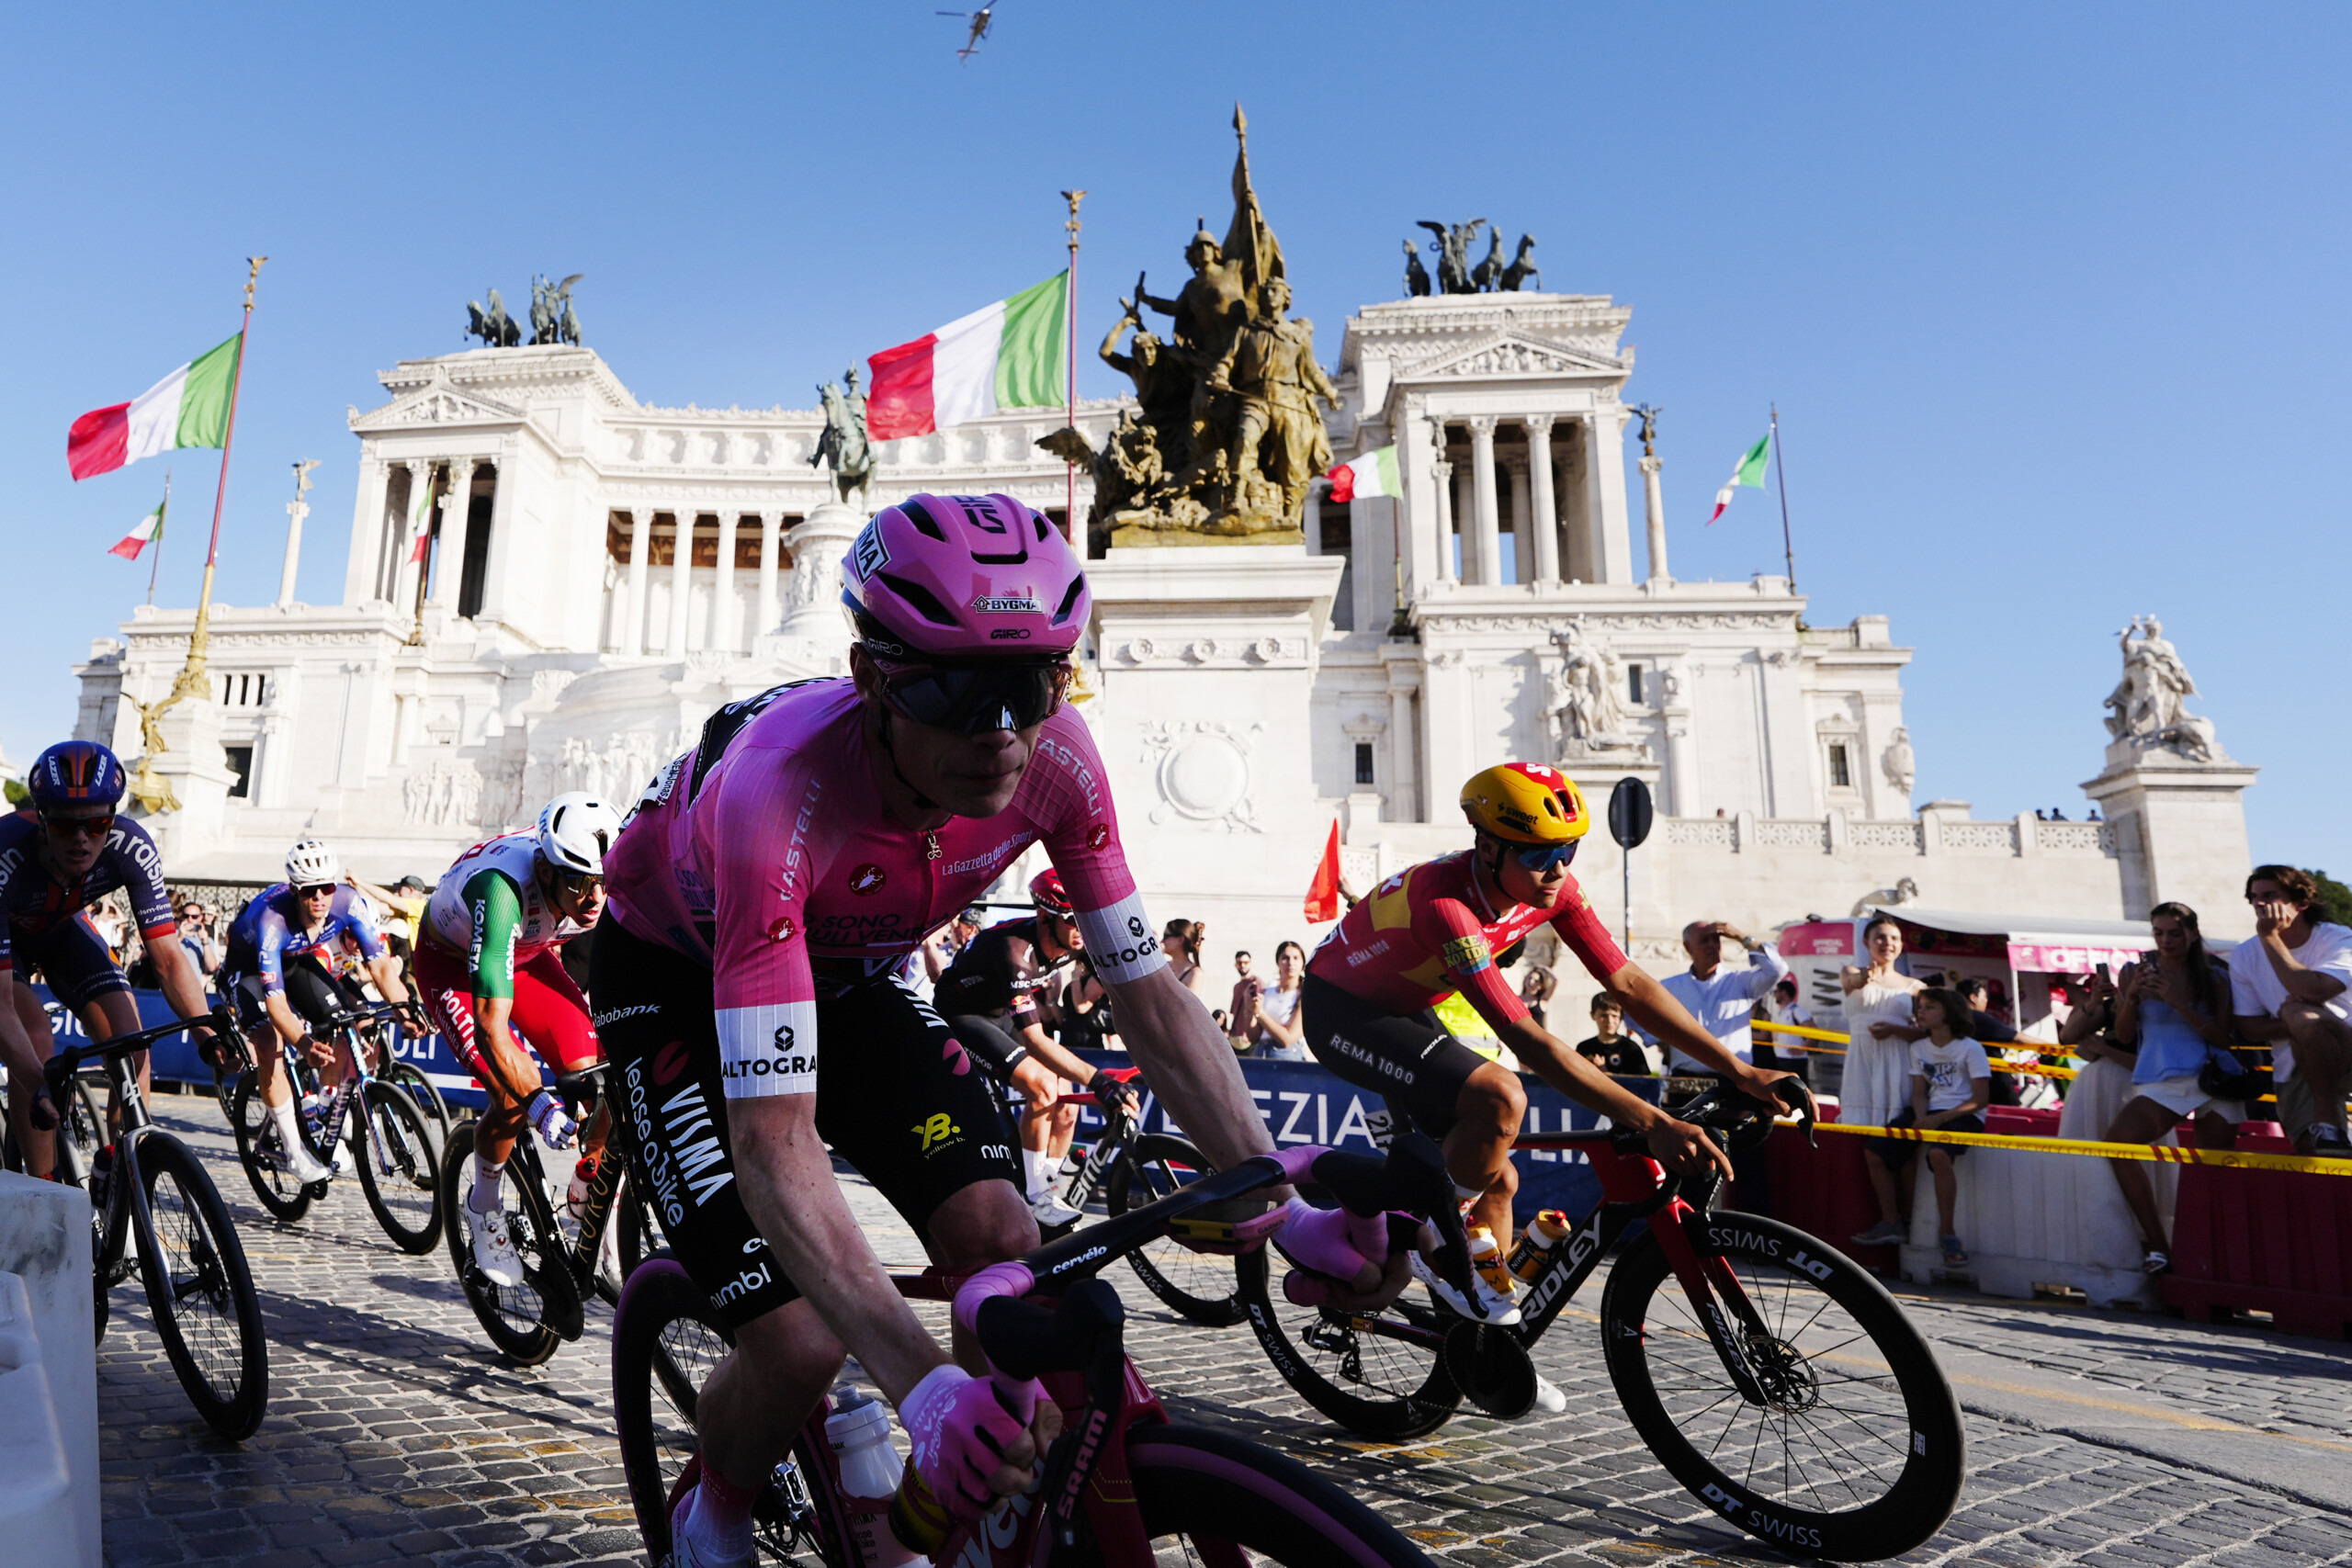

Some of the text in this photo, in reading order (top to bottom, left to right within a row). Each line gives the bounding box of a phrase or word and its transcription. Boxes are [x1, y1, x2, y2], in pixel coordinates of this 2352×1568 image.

[867, 638, 903, 656] GIRO
[990, 628, 1031, 640] GIRO
[48, 756, 61, 786] LAZER
[95, 754, 107, 787] LAZER
[1037, 738, 1102, 818] ASTELLI
[779, 778, 822, 902] CASTELLI
[1507, 807, 1539, 825] sweet
[124, 836, 167, 900] raisin
[942, 864, 953, 875] La
[954, 852, 992, 873] Gazzetta
[992, 840, 1012, 861] dello
[1010, 830, 1034, 849] Sport
[469, 898, 486, 975] KOMETA
[1346, 947, 1372, 968] REMA
[1372, 939, 1391, 958] 1000
[1010, 979, 1031, 989] MSC
[439, 987, 475, 1038] POLTI
[721, 1055, 817, 1080] ALTOGRA
[964, 1046, 993, 1072] TUDOR
[1329, 1032, 1416, 1086] REMA 1000
[660, 1081, 735, 1208] VISMA
[923, 1138, 955, 1160] yellow
[980, 1144, 1016, 1169] nim
[1069, 1140, 1112, 1213] BMC
[1052, 1244, 1108, 1275] cervélo
[1132, 1258, 1163, 1295] SWISS
[1510, 1248, 1529, 1271] RMIN
[1515, 1211, 1602, 1333] RIDLEY
[1707, 1226, 1834, 1281] SWISS DT
[710, 1261, 773, 1312] nimbl
[1249, 1303, 1298, 1378] DT SWISS
[1704, 1302, 1748, 1376] RIDLEY
[1057, 1408, 1108, 1520] SRAM
[1699, 1481, 1824, 1549] DT SWISS
